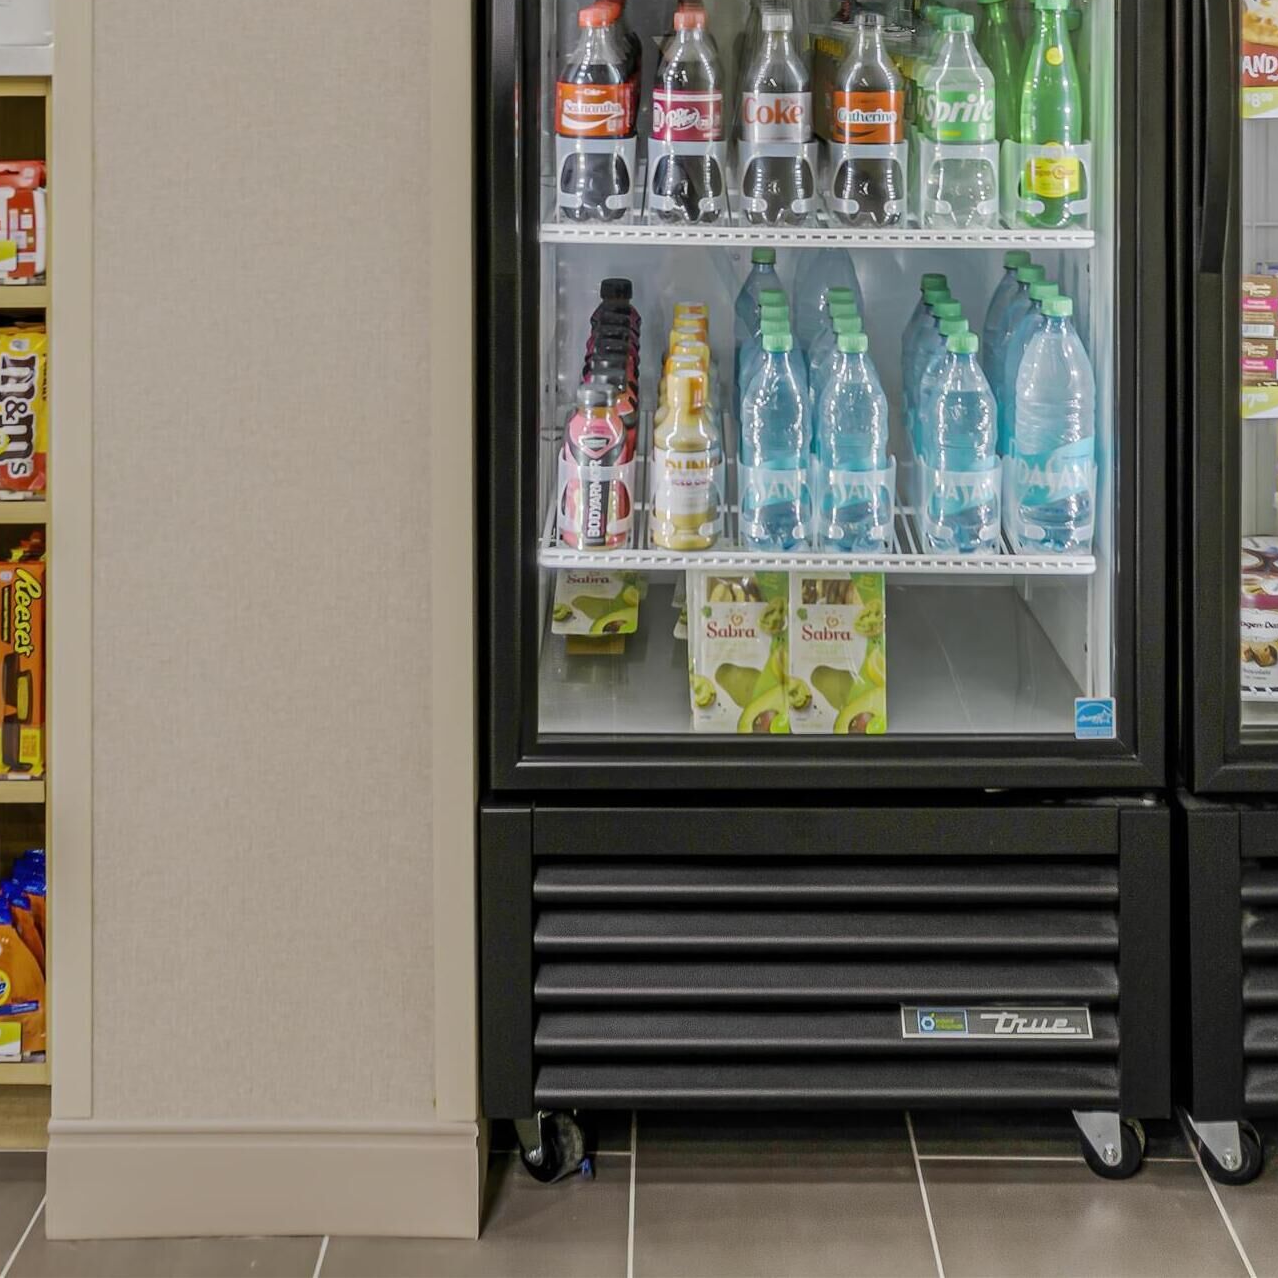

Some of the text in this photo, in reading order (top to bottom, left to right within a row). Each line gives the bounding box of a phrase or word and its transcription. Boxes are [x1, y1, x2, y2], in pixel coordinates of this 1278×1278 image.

[742, 96, 804, 126] Coke
[924, 93, 994, 129] Sprite
[566, 574, 611, 585] Sabra
[706, 622, 757, 639] Sabra
[801, 625, 852, 642] Sabra
